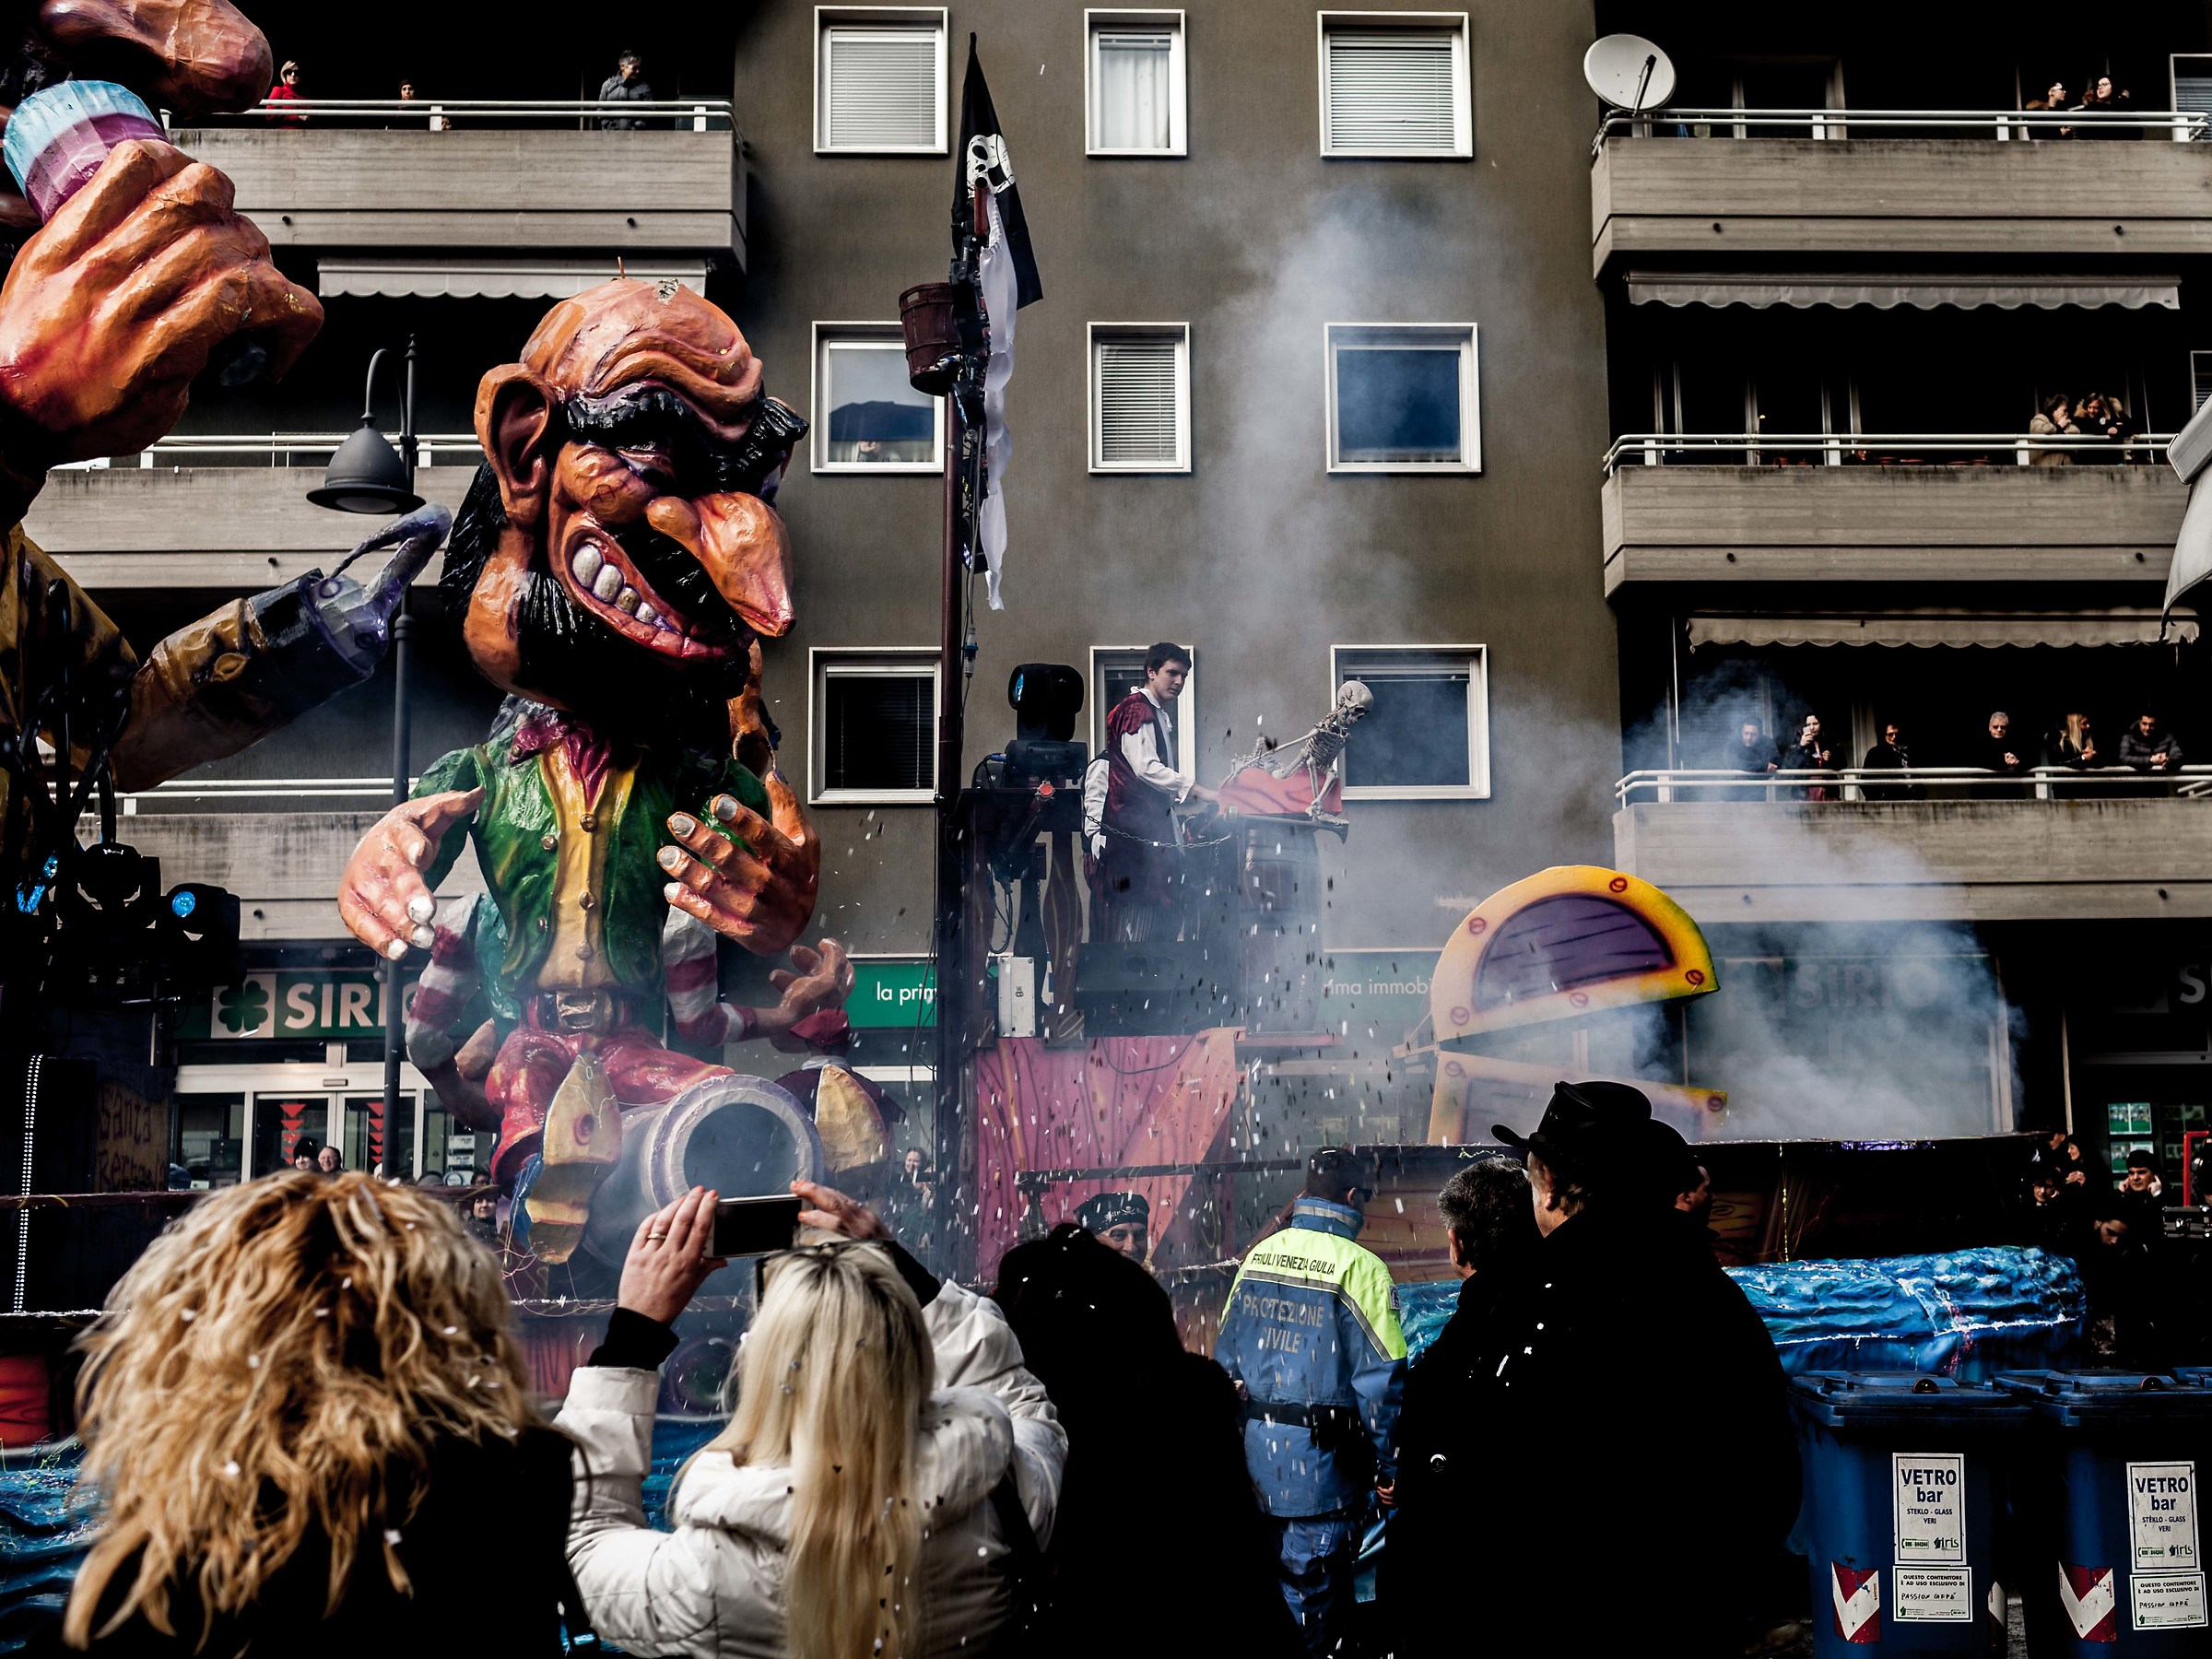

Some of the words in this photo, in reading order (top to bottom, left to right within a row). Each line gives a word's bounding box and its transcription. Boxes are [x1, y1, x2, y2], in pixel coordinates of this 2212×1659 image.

[877, 981, 893, 1001] la
[1369, 975, 1431, 994] immob
[1795, 962, 1940, 1007] SIRIO
[2178, 963, 2211, 1004] S
[1251, 1253, 1275, 1265] FRIULI
[1277, 1254, 1309, 1271] VENEZIA
[1309, 1259, 1335, 1276] GIULIA
[1242, 1294, 1324, 1328] PROTEZIONE
[1901, 1469, 1957, 1486] VETRO
[2135, 1477, 2189, 1493] VETRO
[1917, 1487, 1943, 1502] bar
[2151, 1495, 2176, 1511] bar
[1941, 1537, 1959, 1548] iris
[2176, 1545, 2193, 1555] iris
